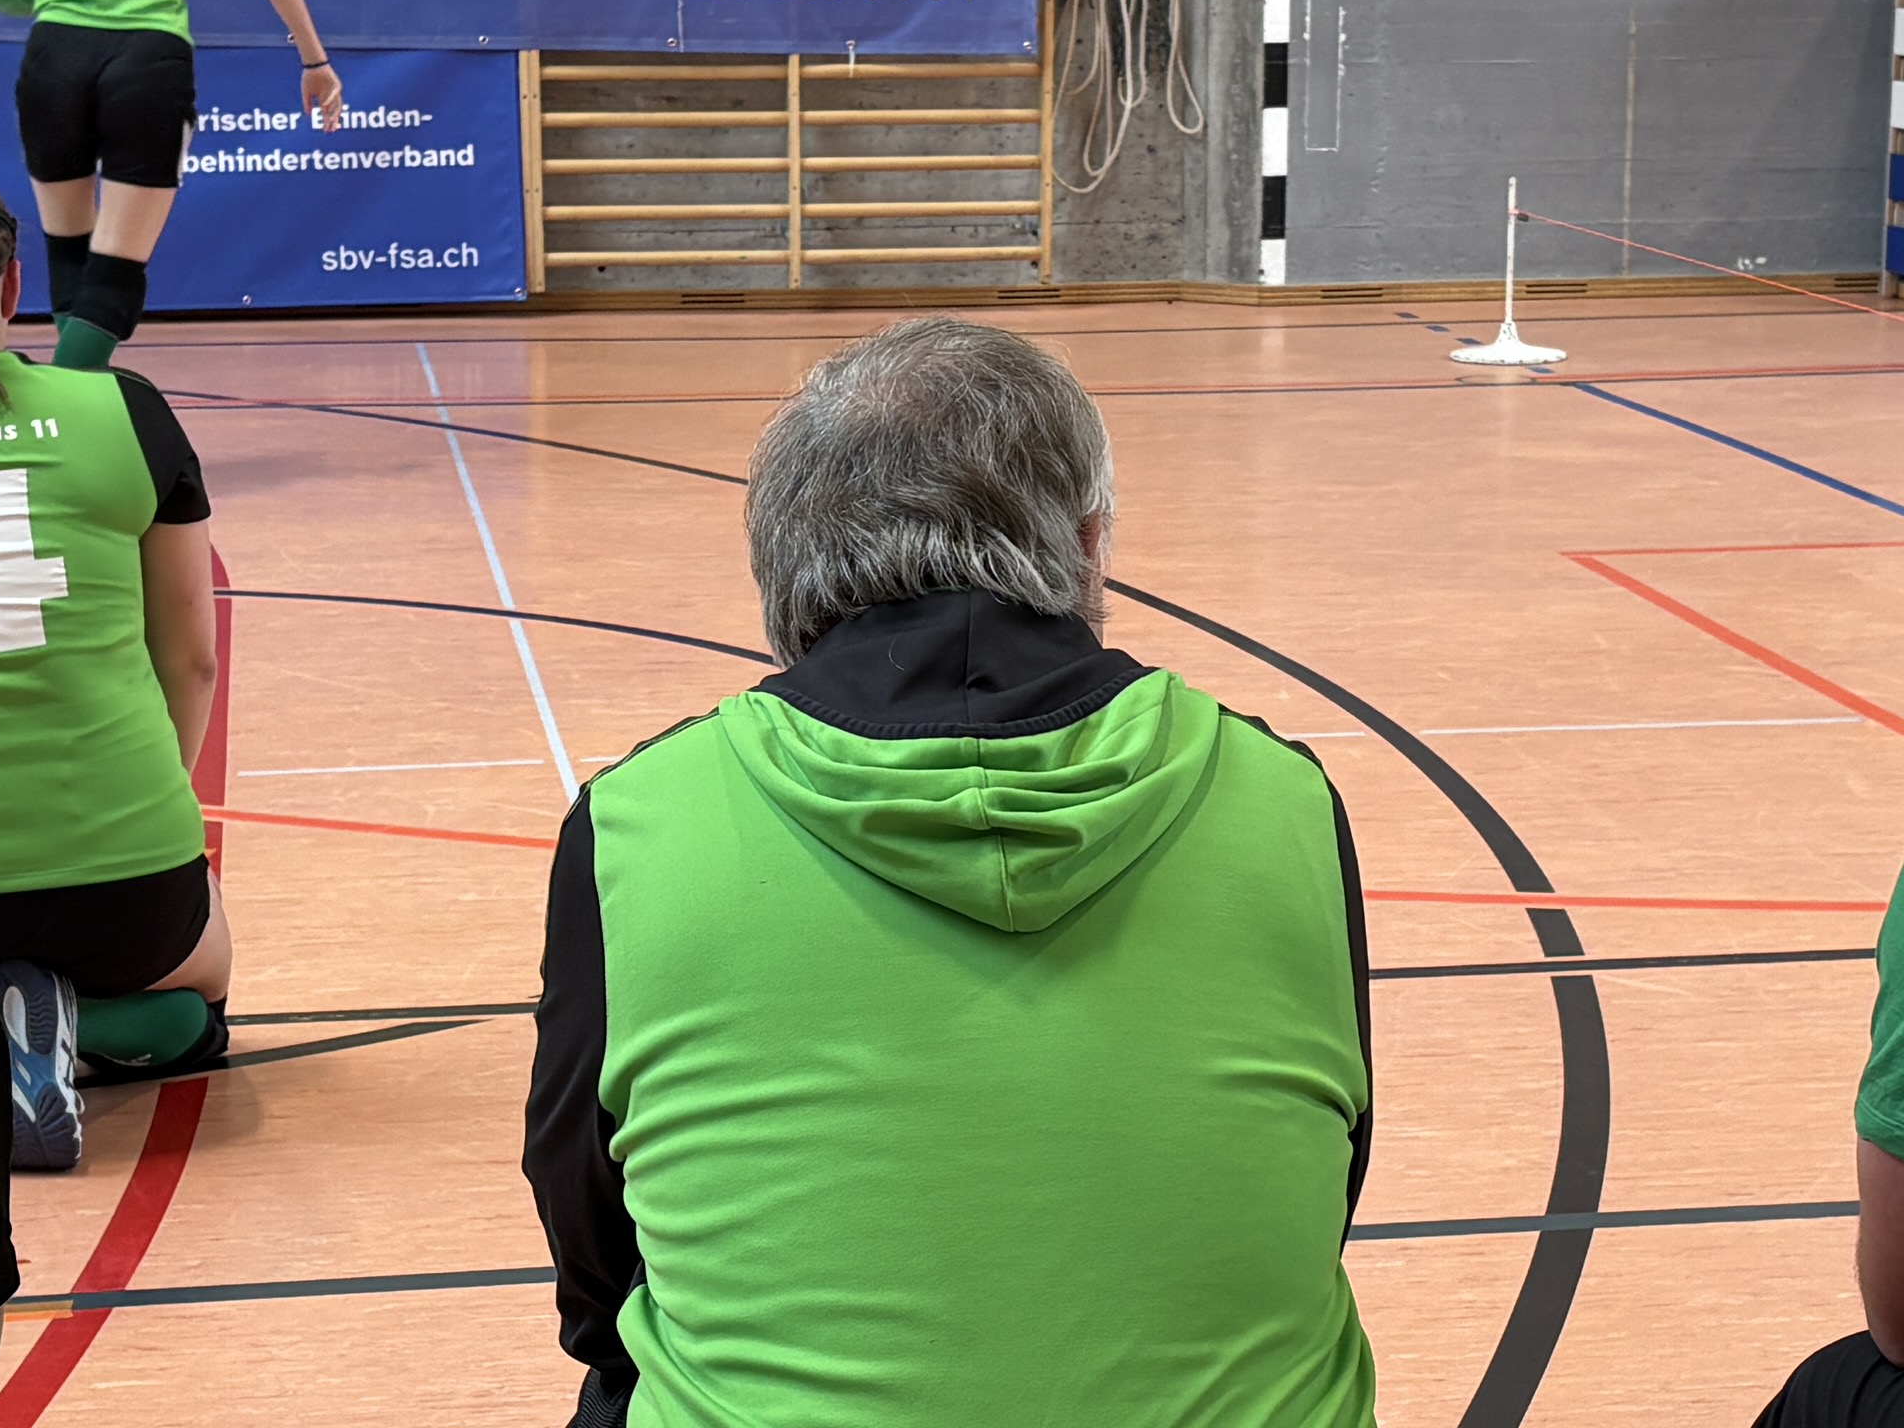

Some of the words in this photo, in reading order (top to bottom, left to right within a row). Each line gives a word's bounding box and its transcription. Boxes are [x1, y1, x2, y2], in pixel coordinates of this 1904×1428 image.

[311, 105, 433, 130] Binden-
[321, 242, 479, 272] sbv-fsa.ch
[30, 418, 60, 439] 11
